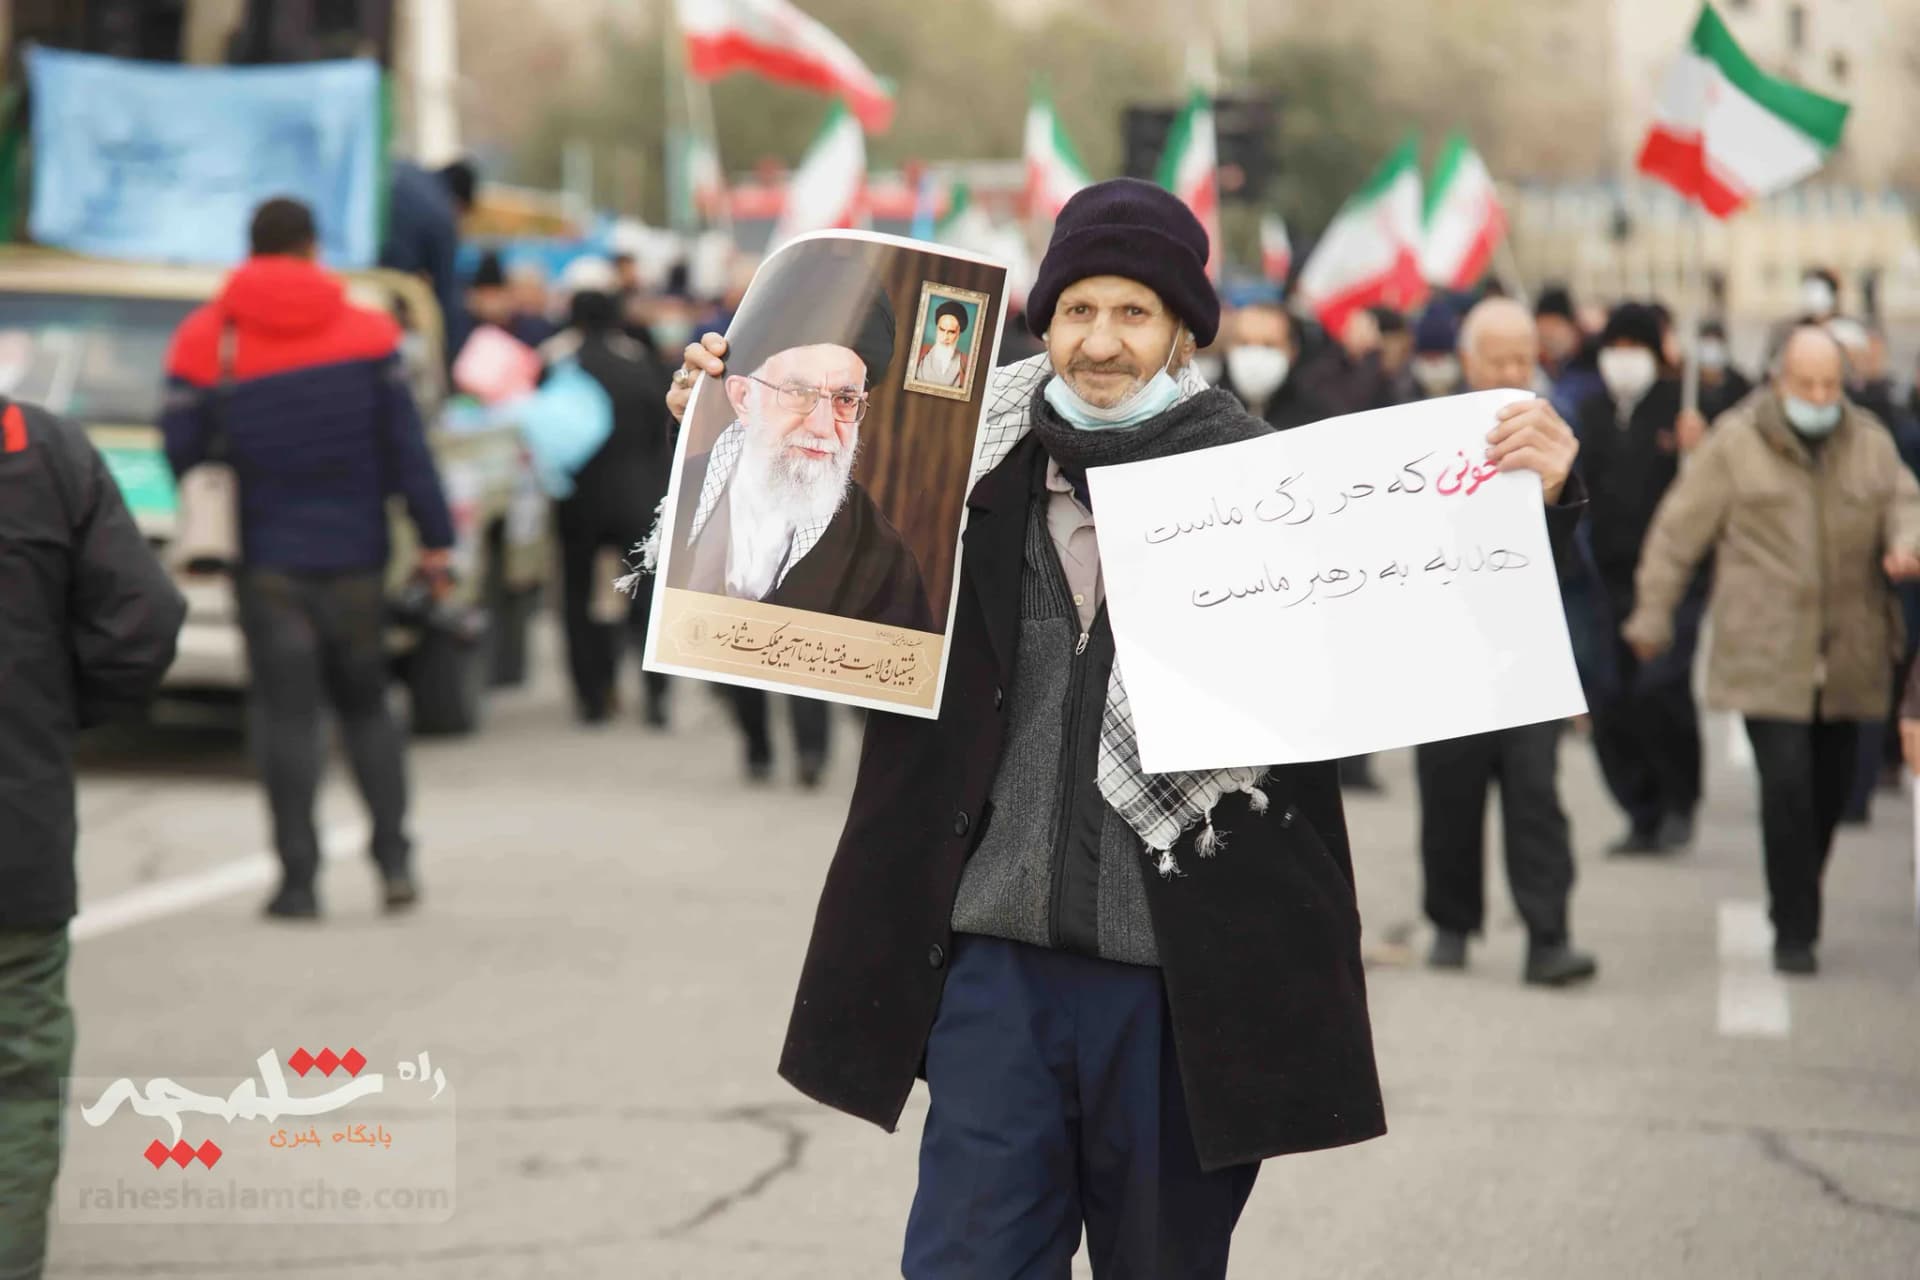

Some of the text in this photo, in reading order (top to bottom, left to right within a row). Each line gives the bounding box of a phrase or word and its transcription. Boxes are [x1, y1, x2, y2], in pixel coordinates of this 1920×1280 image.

[1388, 452, 1436, 494] که
[1254, 472, 1316, 525] رگ
[1328, 482, 1375, 515] در
[1145, 495, 1243, 545] ماست
[1191, 545, 1530, 609] هدیه به رهبر ماست
[828, 644, 848, 675] فقیه
[839, 656, 892, 680] ولایت
[878, 652, 917, 686] پشتیبان
